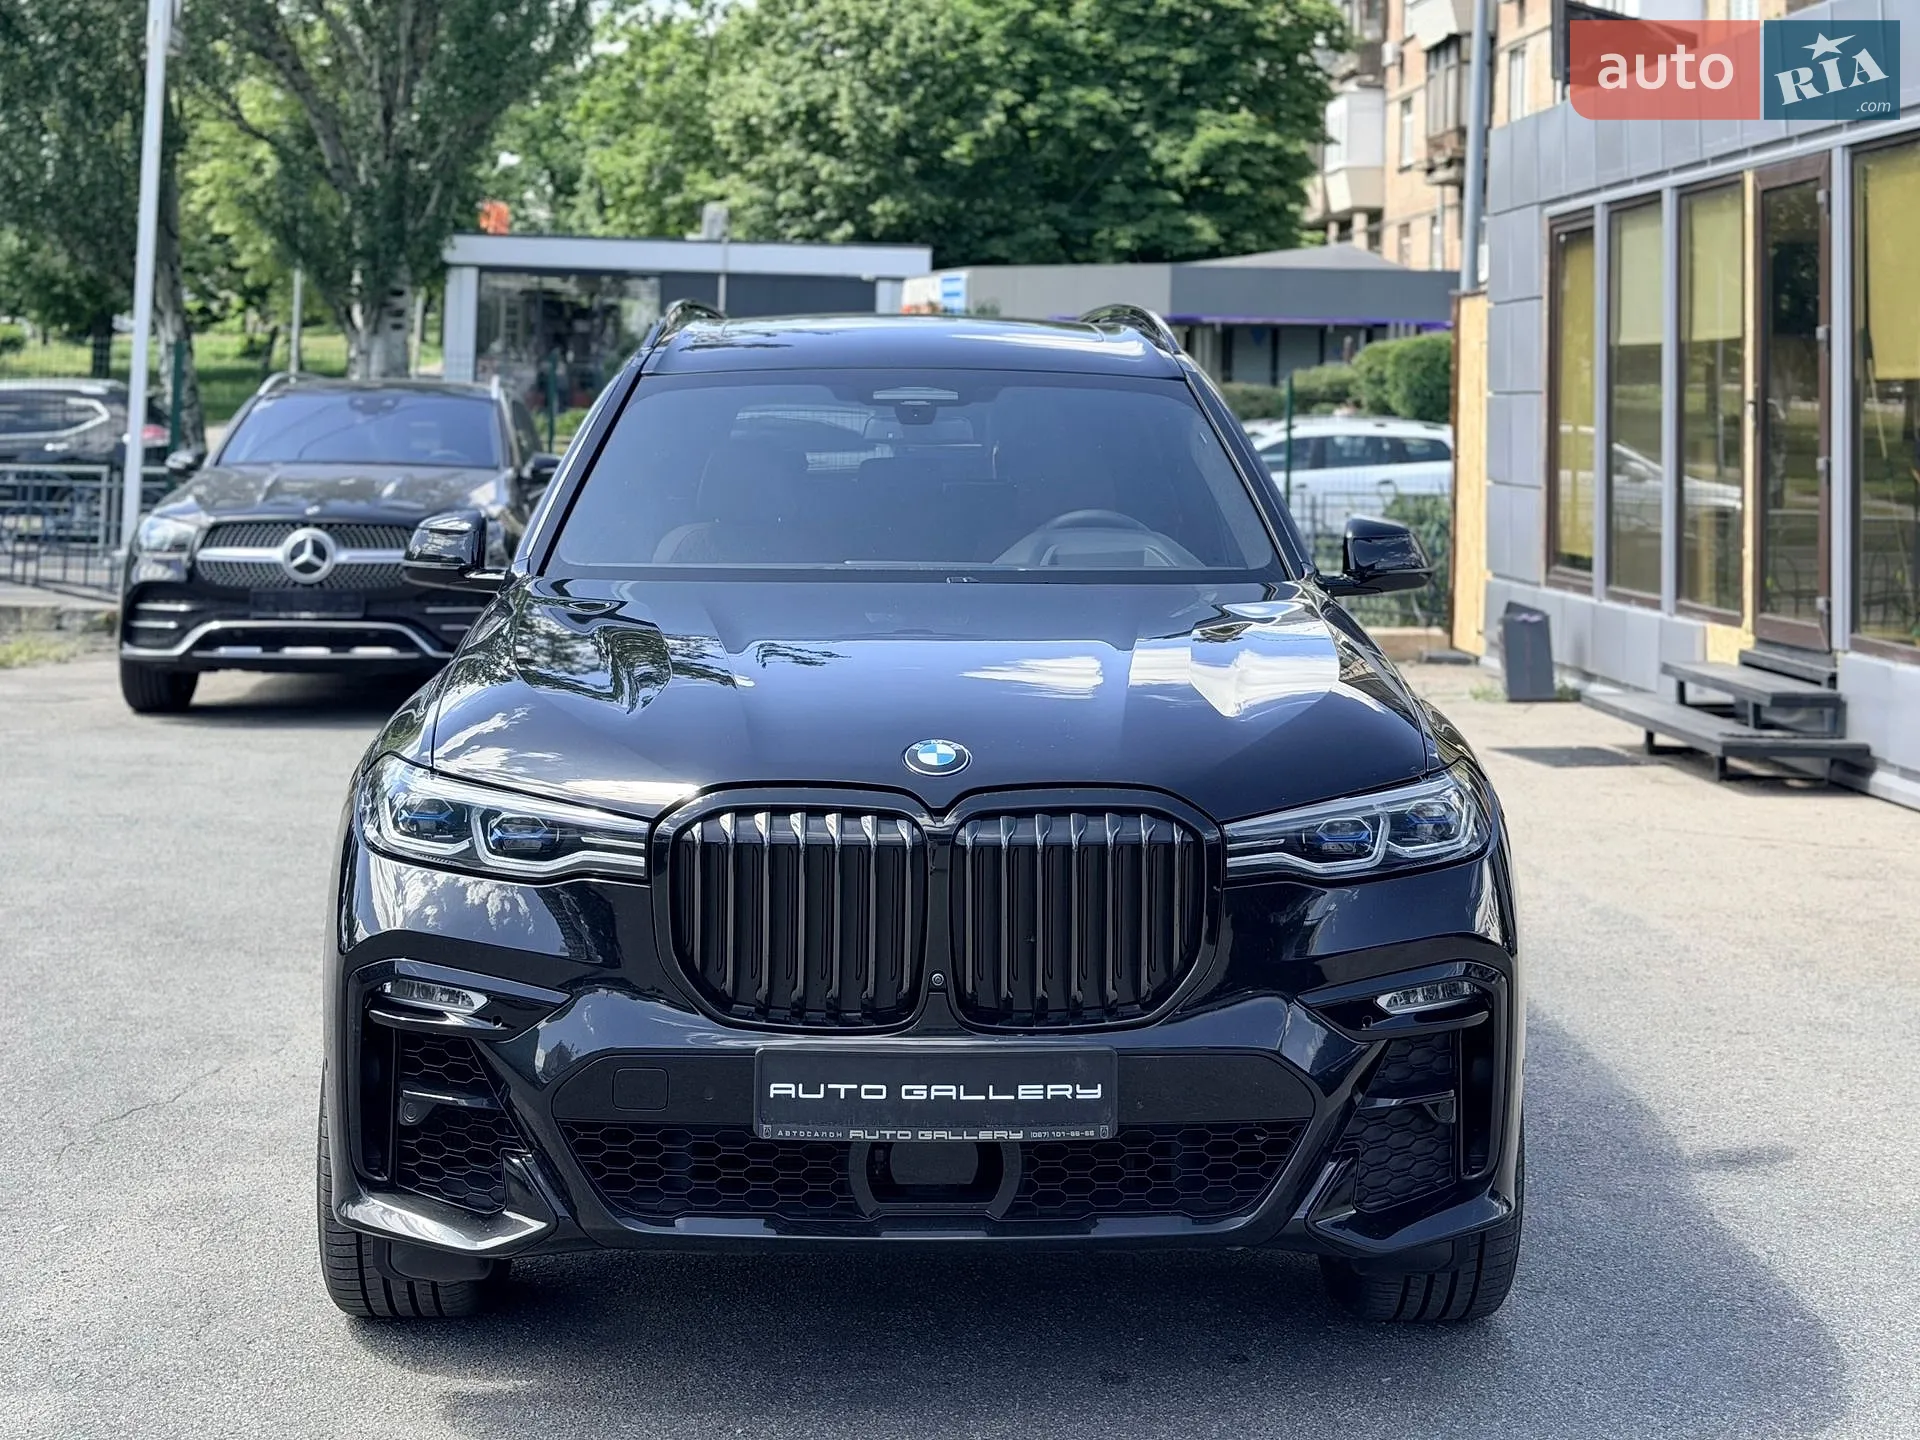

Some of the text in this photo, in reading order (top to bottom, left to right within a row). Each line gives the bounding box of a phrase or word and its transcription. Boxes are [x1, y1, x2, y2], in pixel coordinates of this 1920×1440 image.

[770, 1083, 1102, 1100] AUTO GALLERY
[778, 1130, 843, 1138] АВТОСАЛОН
[849, 1130, 912, 1139] AUTO
[918, 1130, 1024, 1140] GALLERY
